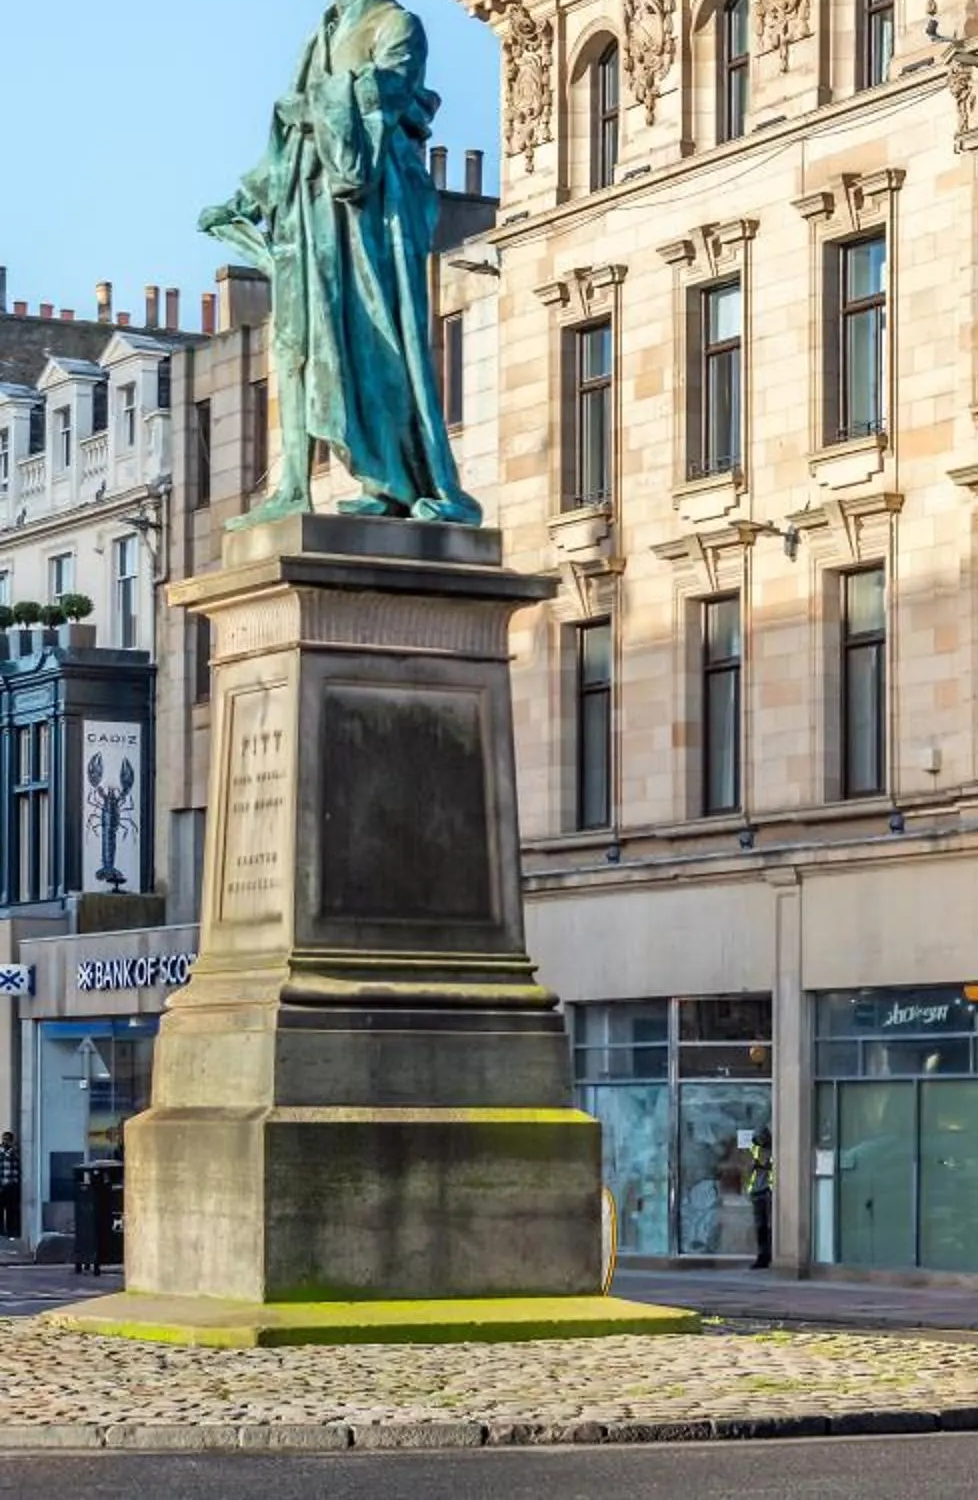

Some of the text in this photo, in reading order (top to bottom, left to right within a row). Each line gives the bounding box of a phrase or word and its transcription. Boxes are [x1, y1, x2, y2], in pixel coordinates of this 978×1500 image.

[87, 733, 137, 746] CADIZ
[95, 959, 133, 989] BANK
[134, 957, 156, 986] OF
